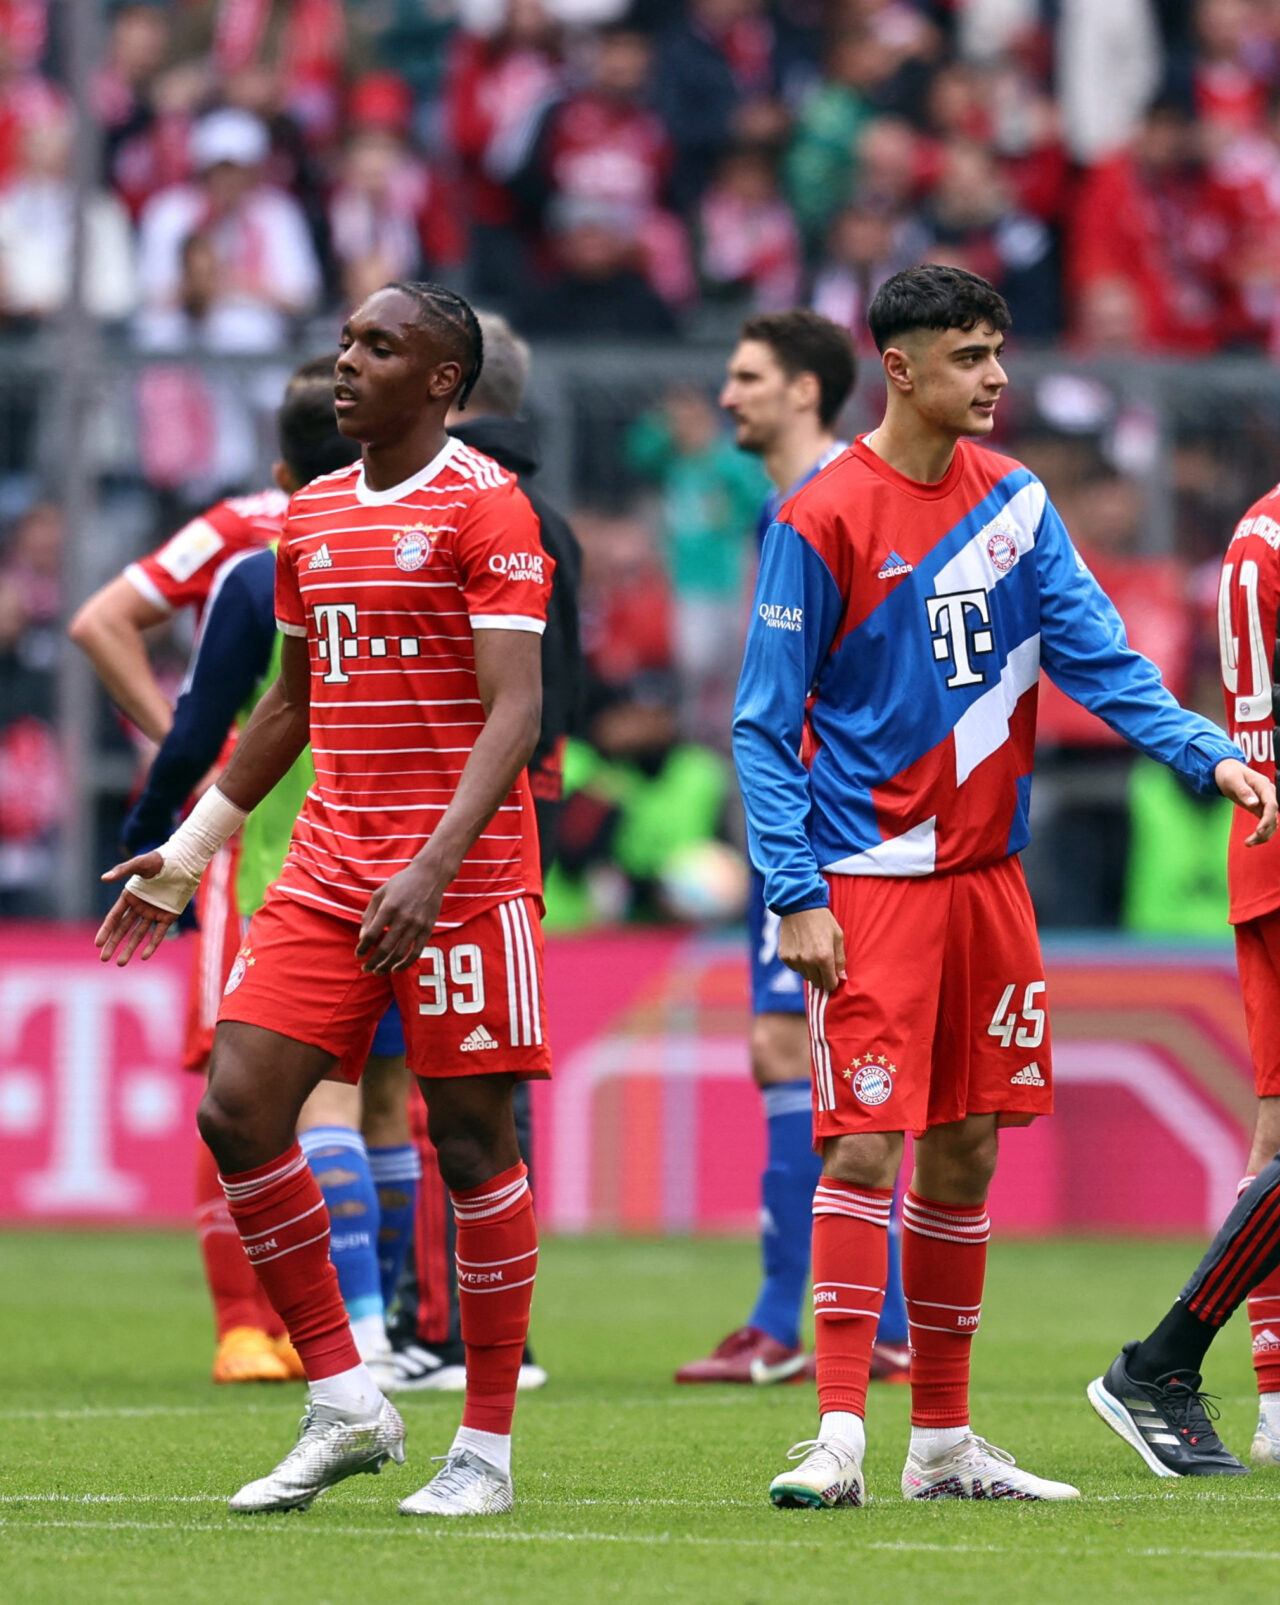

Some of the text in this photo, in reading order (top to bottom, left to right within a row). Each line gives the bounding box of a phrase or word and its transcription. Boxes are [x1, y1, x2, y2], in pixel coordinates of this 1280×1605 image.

[488, 552, 544, 574] QATAR
[878, 563, 913, 580] adidas
[759, 603, 803, 622] QATAR
[766, 619, 802, 632] AIRWAYS
[419, 943, 485, 1015] 39
[987, 980, 1046, 1048] 45
[459, 1040, 499, 1052] adidas
[1010, 1076, 1045, 1087] adidas
